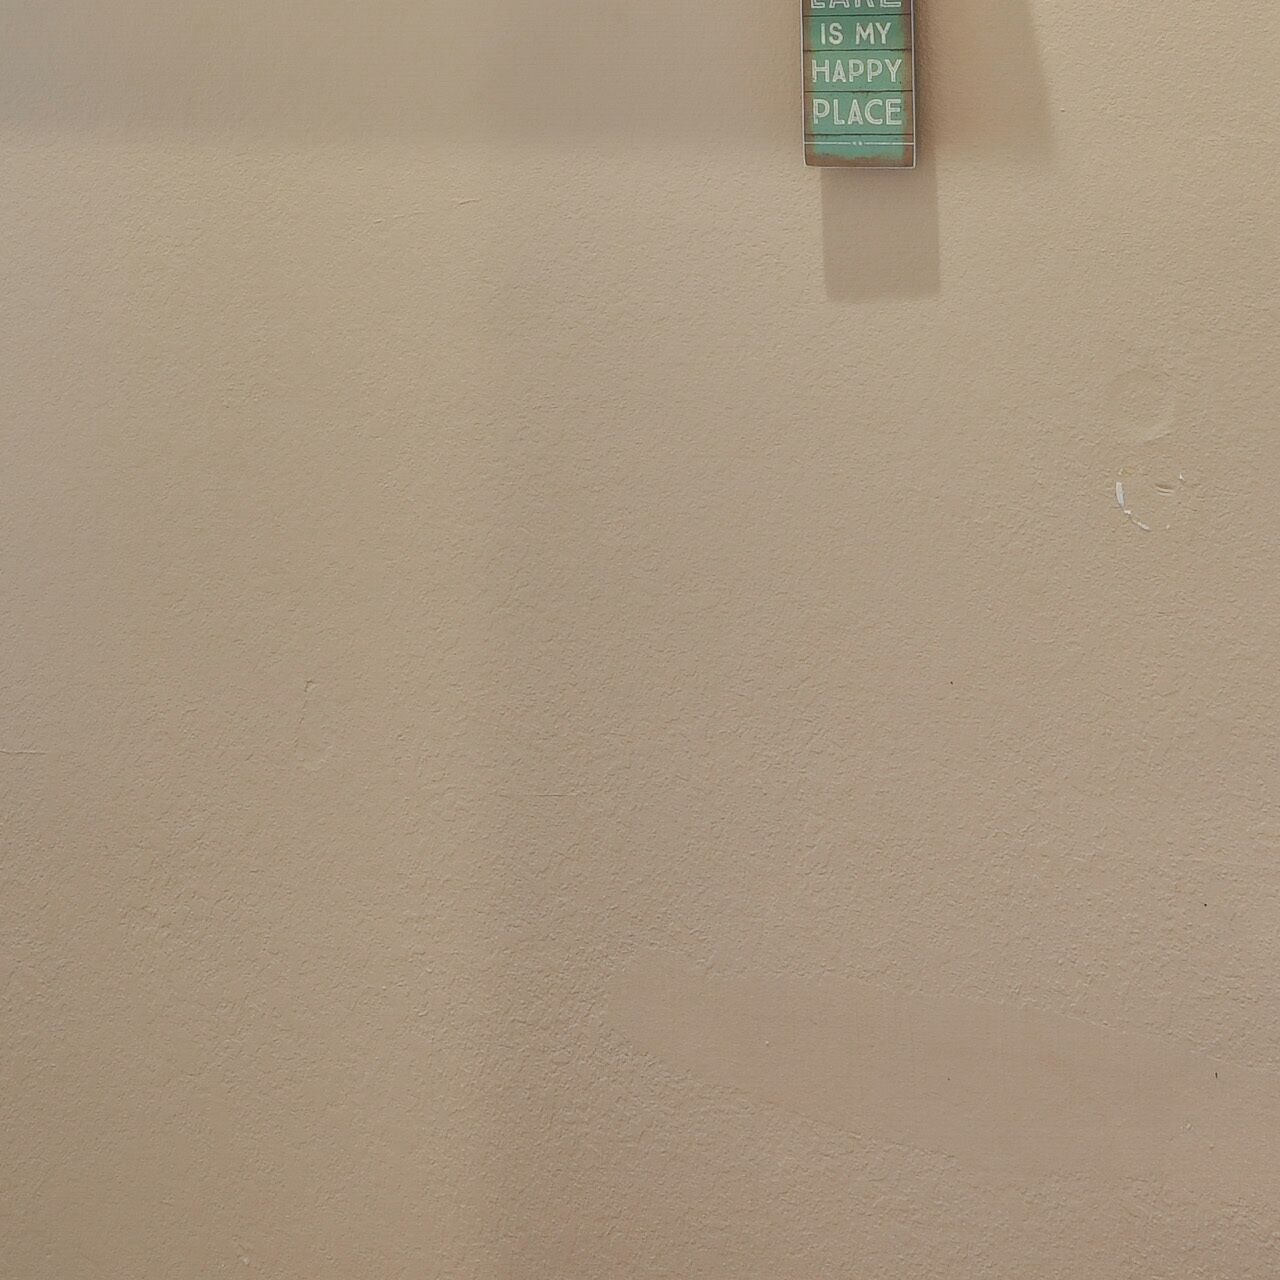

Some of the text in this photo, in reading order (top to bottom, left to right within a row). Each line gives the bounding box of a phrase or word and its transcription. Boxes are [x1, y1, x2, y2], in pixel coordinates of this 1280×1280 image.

[821, 22, 892, 45] IS MY
[812, 58, 902, 83] HAPPY
[813, 98, 903, 126] PLACE
